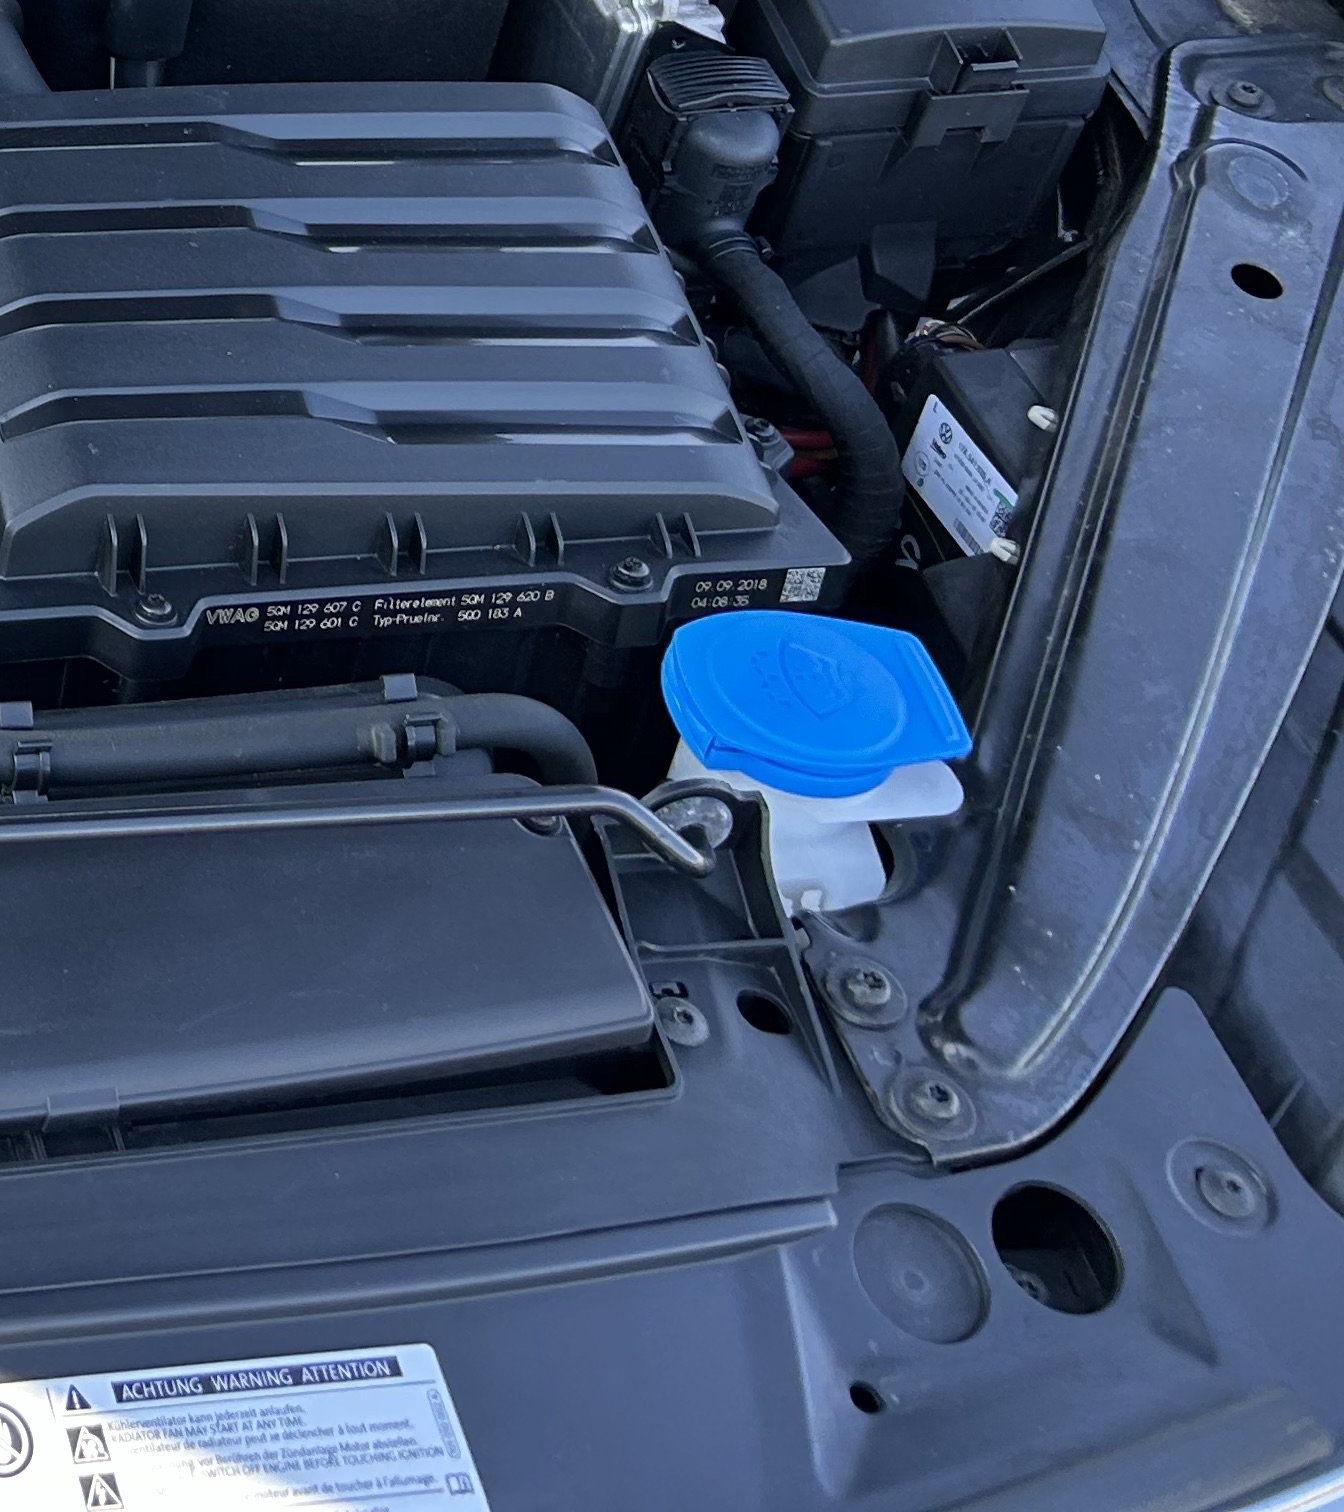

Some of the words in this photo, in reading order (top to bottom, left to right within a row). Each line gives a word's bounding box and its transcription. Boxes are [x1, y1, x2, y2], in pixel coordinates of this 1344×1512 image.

[265, 604, 291, 617] 5QM
[297, 603, 319, 615] 129
[323, 601, 348, 613] 607
[351, 600, 362, 612] C
[374, 595, 457, 610] Filterelement
[460, 593, 485, 606] 5QM
[491, 592, 513, 604] 129
[516, 590, 541, 602] 620
[544, 589, 555, 601] B
[263, 619, 288, 632] 5QM
[294, 618, 316, 630] 129
[319, 616, 342, 629] 601
[348, 615, 359, 627] C
[487, 607, 509, 620] 183
[512, 606, 522, 618] A
[121, 1376, 204, 1402] ACHTUNG
[210, 1368, 292, 1392] WARNING
[301, 1359, 391, 1385] ATTENTION
[163, 1427, 184, 1439] FAN
[185, 1425, 208, 1437] MAY
[211, 1421, 240, 1435] START
[242, 1420, 254, 1432] AT
[256, 1417, 277, 1430] ANY
[187, 1412, 213, 1425] kann
